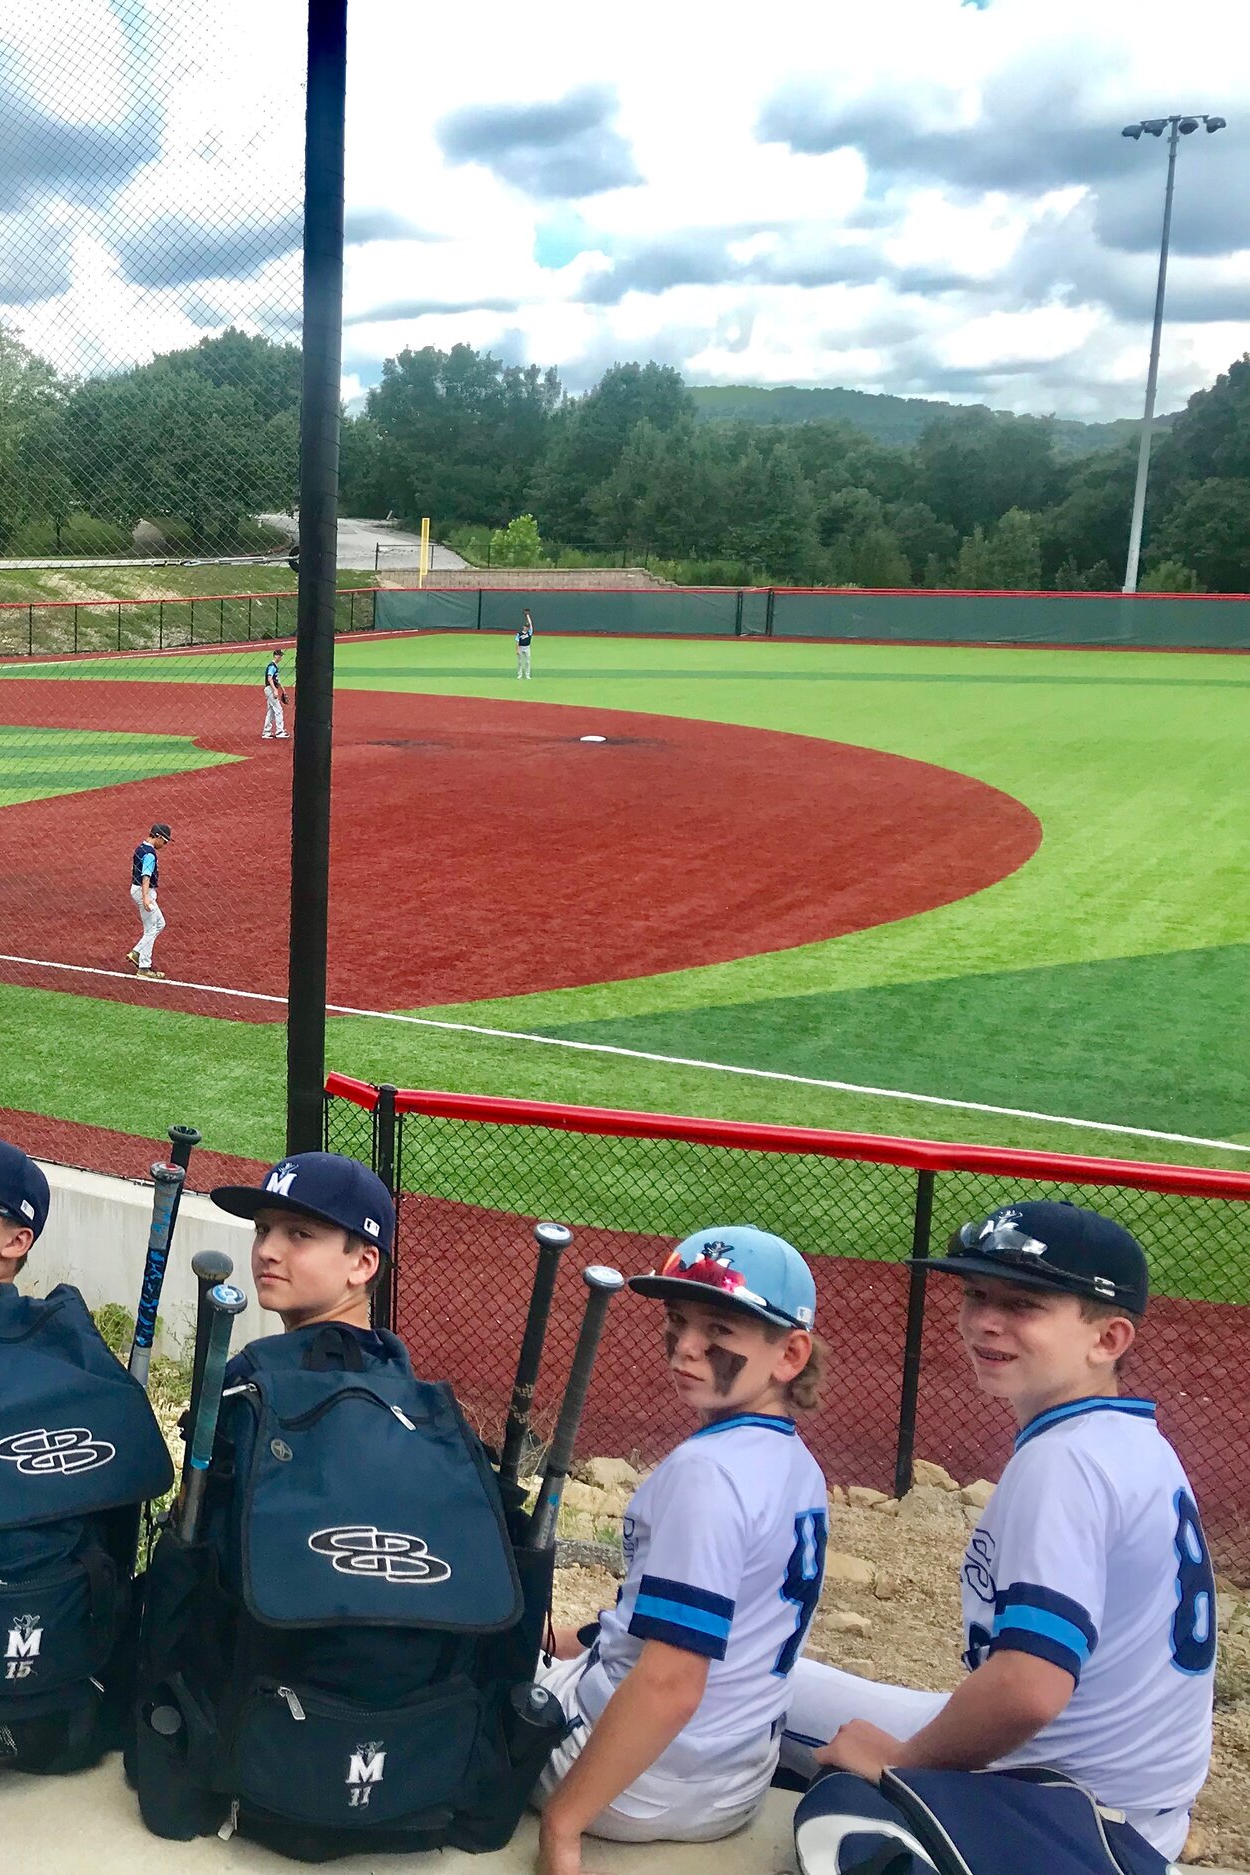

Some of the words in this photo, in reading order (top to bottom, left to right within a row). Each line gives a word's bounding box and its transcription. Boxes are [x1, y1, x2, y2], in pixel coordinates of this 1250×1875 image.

[266, 1171, 298, 1198] M
[1169, 1487, 1217, 1676] 8
[3, 1628, 44, 1658] M
[5, 1660, 34, 1680] 15
[345, 1752, 388, 1784] M
[348, 1785, 373, 1807] 11
